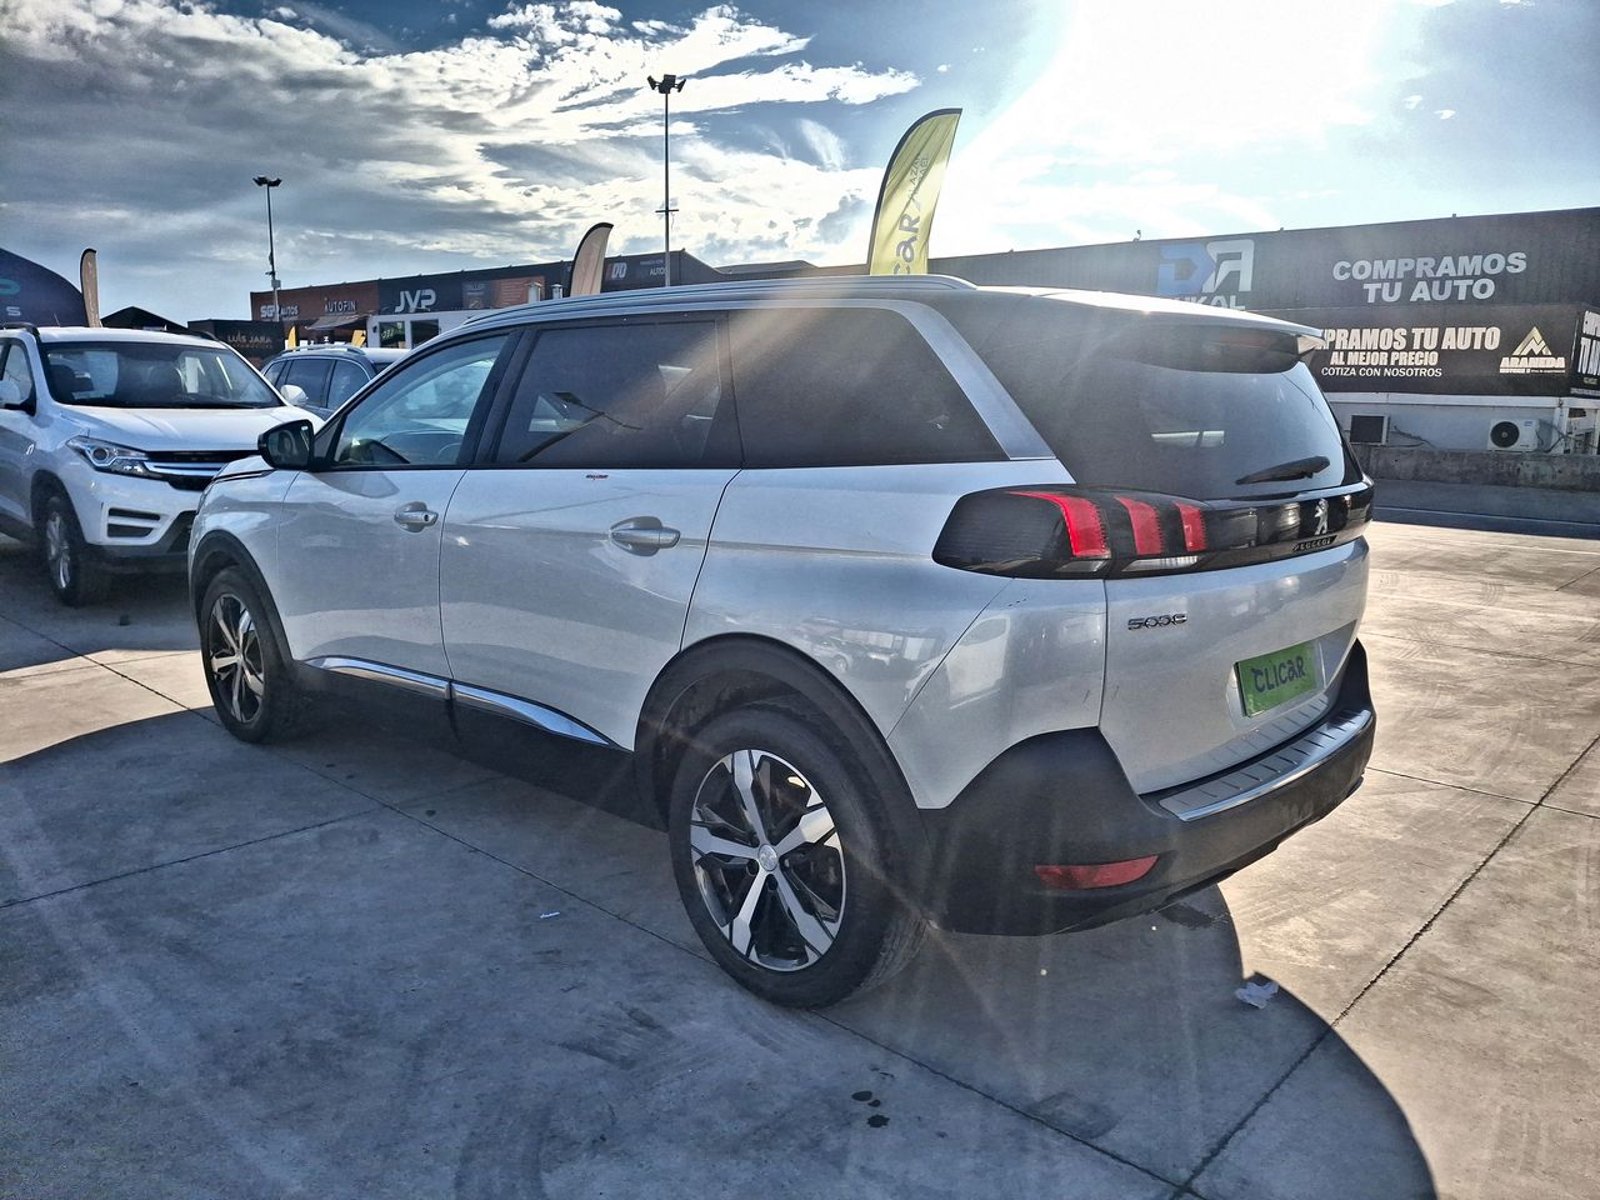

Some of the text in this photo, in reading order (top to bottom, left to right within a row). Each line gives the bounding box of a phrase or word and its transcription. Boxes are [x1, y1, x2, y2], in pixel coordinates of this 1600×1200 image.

[1333, 252, 1527, 281] COMPRAMOS
[1363, 278, 1496, 304] TU AUTO
[1412, 327, 1439, 350] TU
[1441, 326, 1501, 351] AUTO
[1330, 351, 1439, 367] AL MEJOR PRECIO
[1321, 366, 1443, 378] COTIZA CON NOSOTROS
